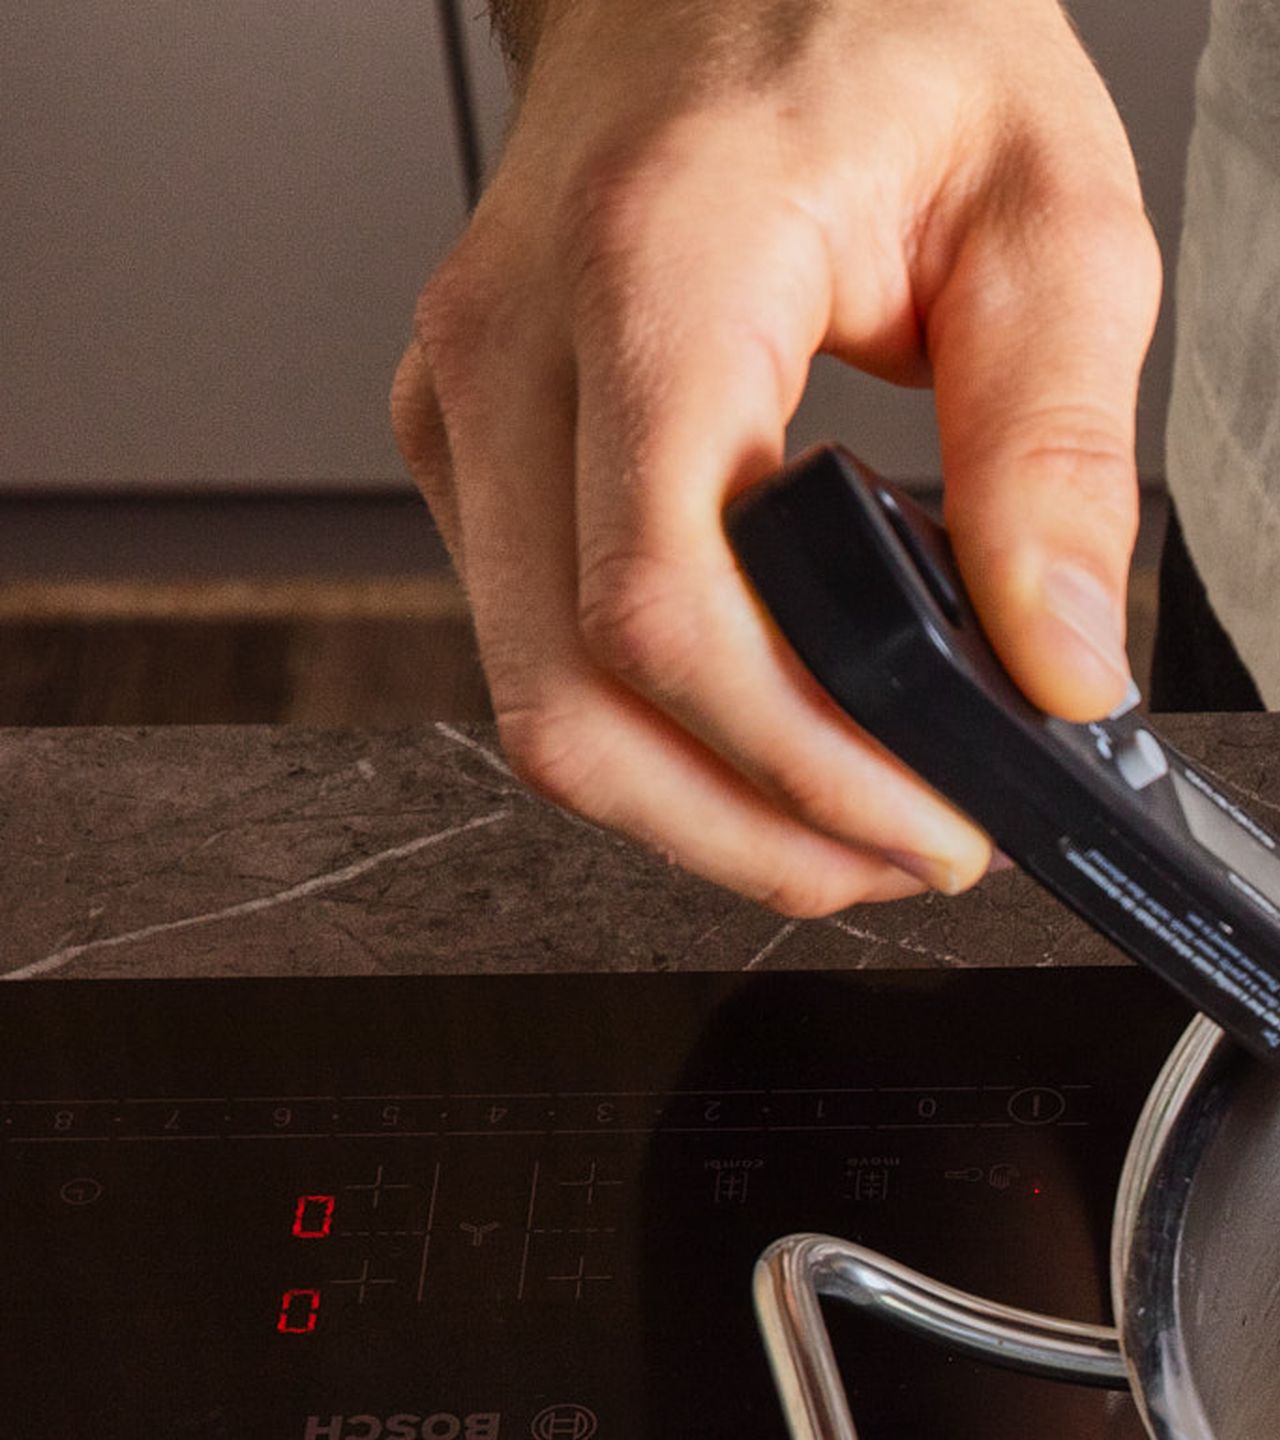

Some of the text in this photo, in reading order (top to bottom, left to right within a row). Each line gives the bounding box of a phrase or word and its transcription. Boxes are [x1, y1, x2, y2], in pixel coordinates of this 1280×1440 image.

[272, 1107, 292, 1128] 6
[381, 1106, 401, 1126] 5
[487, 1105, 509, 1124] 4
[596, 1103, 615, 1122] 3
[703, 1101, 722, 1122] 2
[917, 1098, 937, 1119] 0
[53, 1111, 75, 1131] 8
[164, 1110, 180, 1130] 7
[703, 1158, 766, 1170] combi
[845, 1156, 901, 1166] move
[292, 1194, 336, 1239] 0
[276, 1288, 321, 1334] 0
